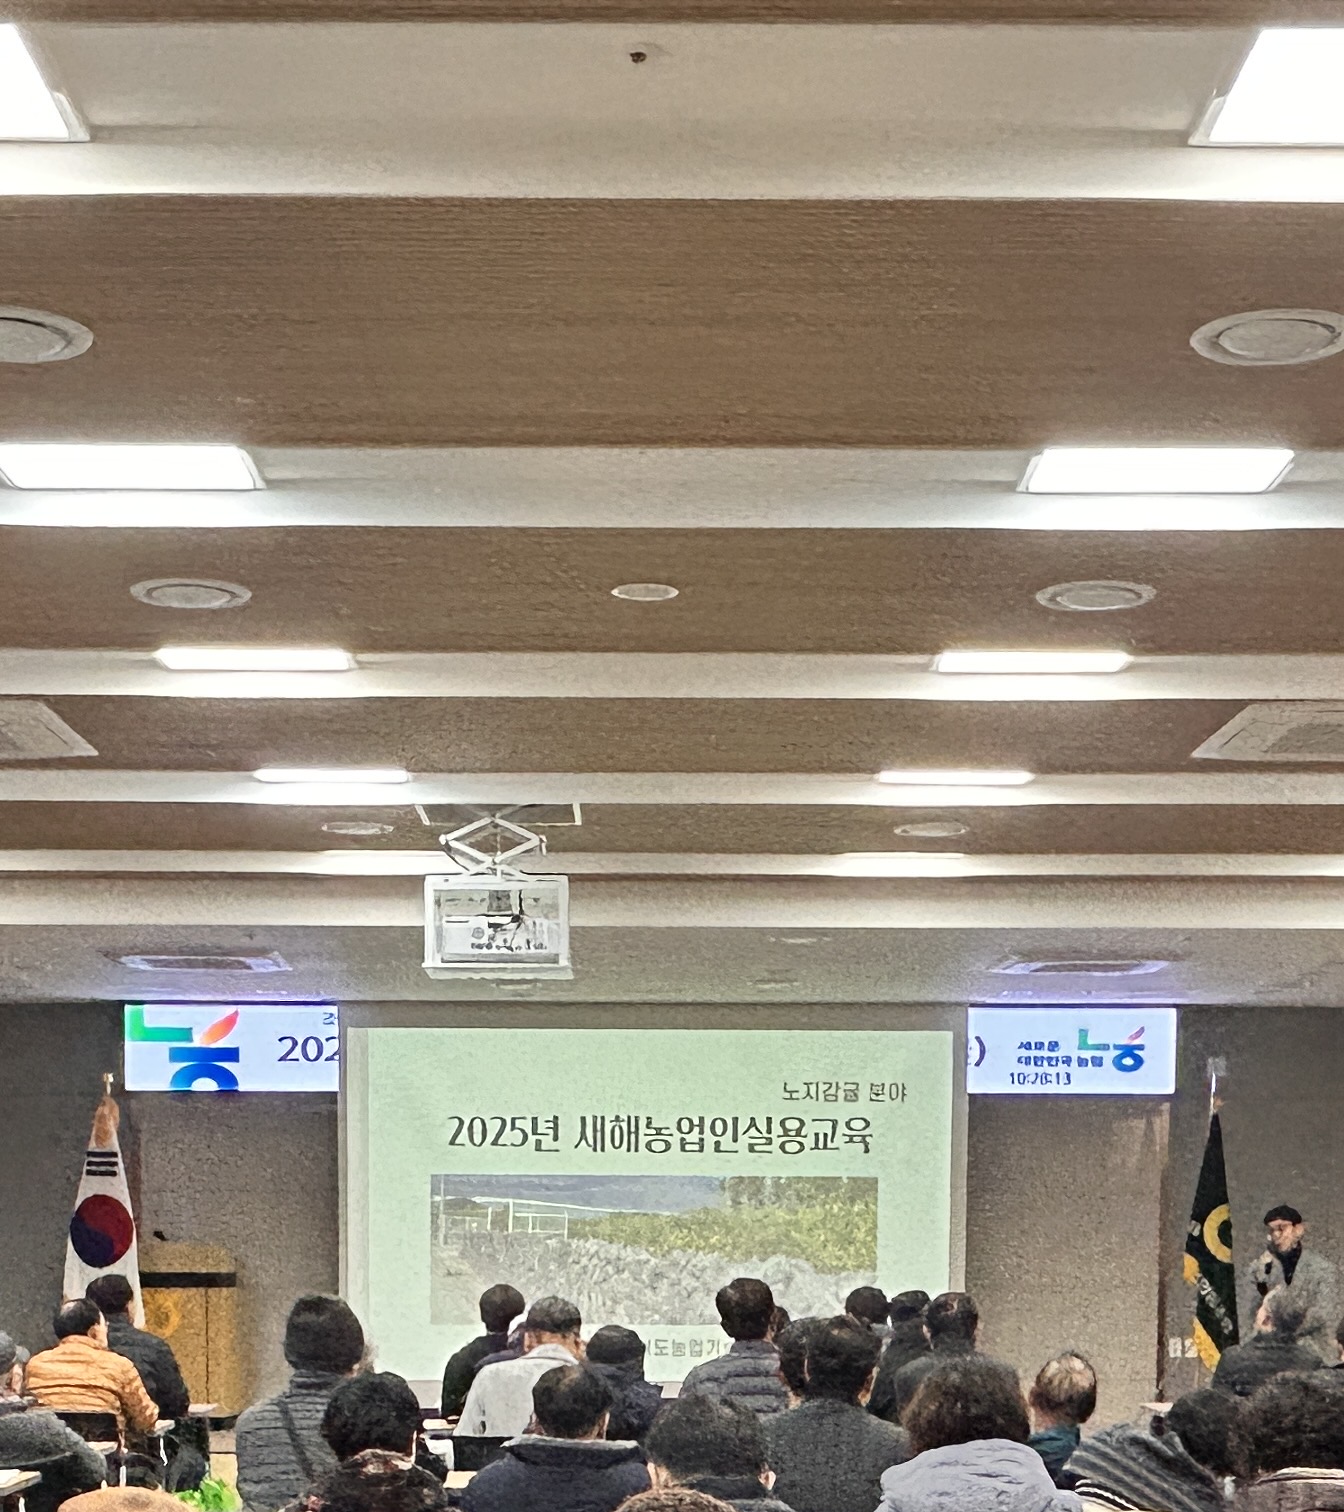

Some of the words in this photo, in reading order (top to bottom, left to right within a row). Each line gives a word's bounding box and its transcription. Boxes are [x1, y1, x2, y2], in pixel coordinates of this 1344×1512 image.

[782, 1081, 859, 1102] 노지감귤
[869, 1082, 908, 1103] 분야
[448, 1115, 560, 1153] 2025년
[574, 1114, 873, 1155] 새해농업인실용교육
